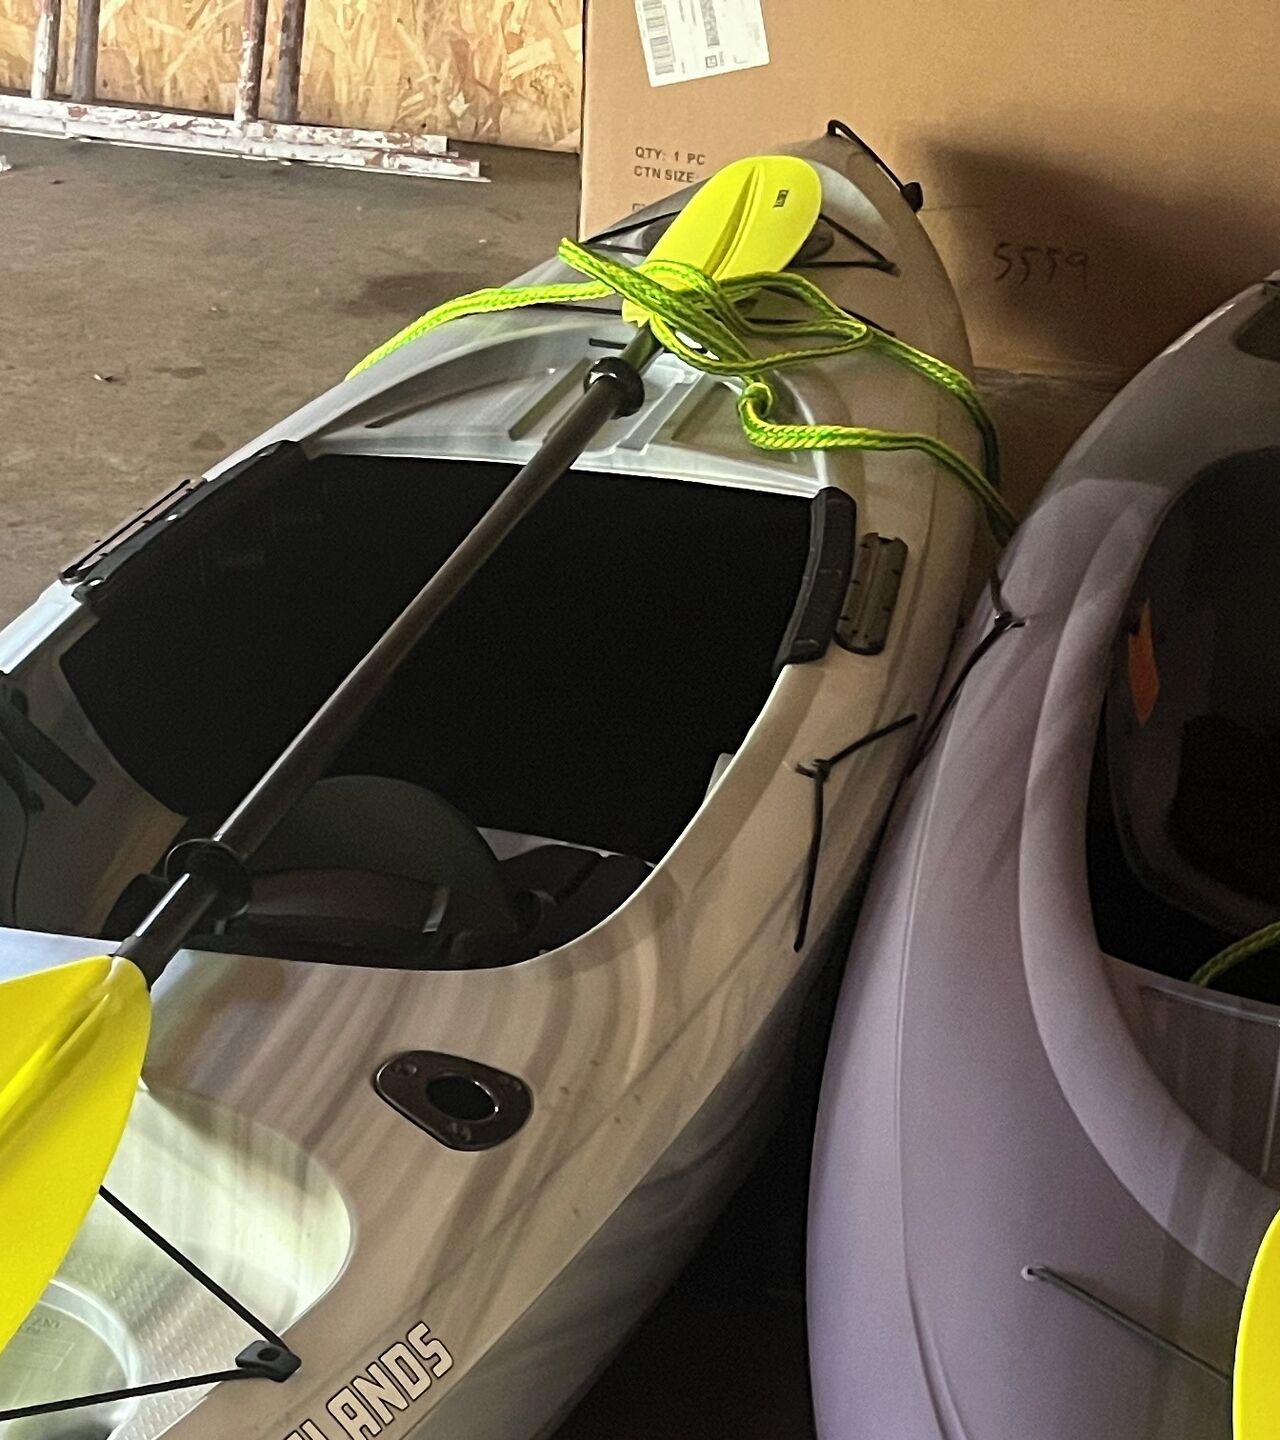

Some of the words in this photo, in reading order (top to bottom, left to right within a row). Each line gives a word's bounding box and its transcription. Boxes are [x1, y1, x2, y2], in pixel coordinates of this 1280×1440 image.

[674, 150, 680, 162] 1
[687, 153, 705, 166] PC
[633, 166, 661, 179] CTN
